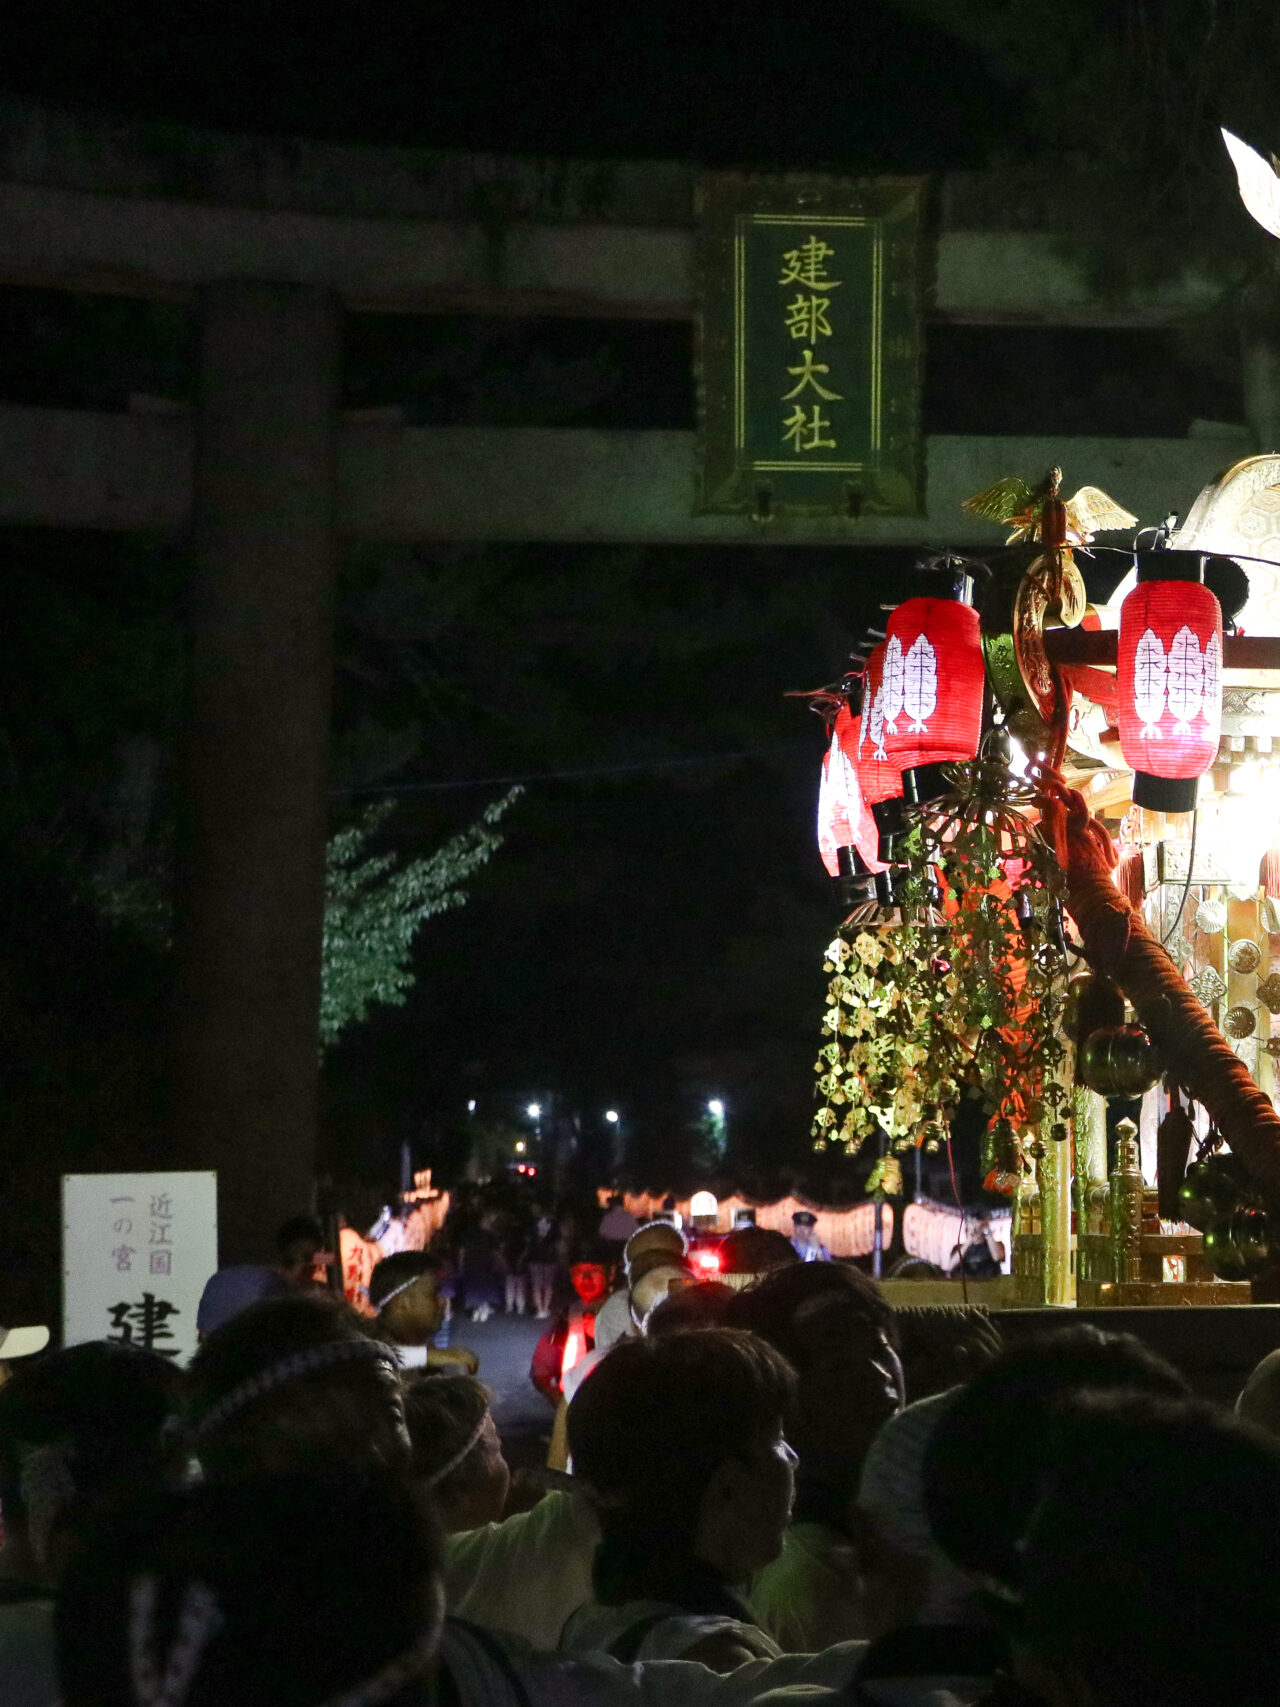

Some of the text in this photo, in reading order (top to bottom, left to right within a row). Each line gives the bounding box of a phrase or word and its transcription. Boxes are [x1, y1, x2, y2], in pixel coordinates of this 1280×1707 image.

[778, 235, 845, 453] 建部大社
[110, 1196, 136, 1271] 一の宮
[149, 1193, 174, 1275] 近江国
[107, 1292, 182, 1357] 建
